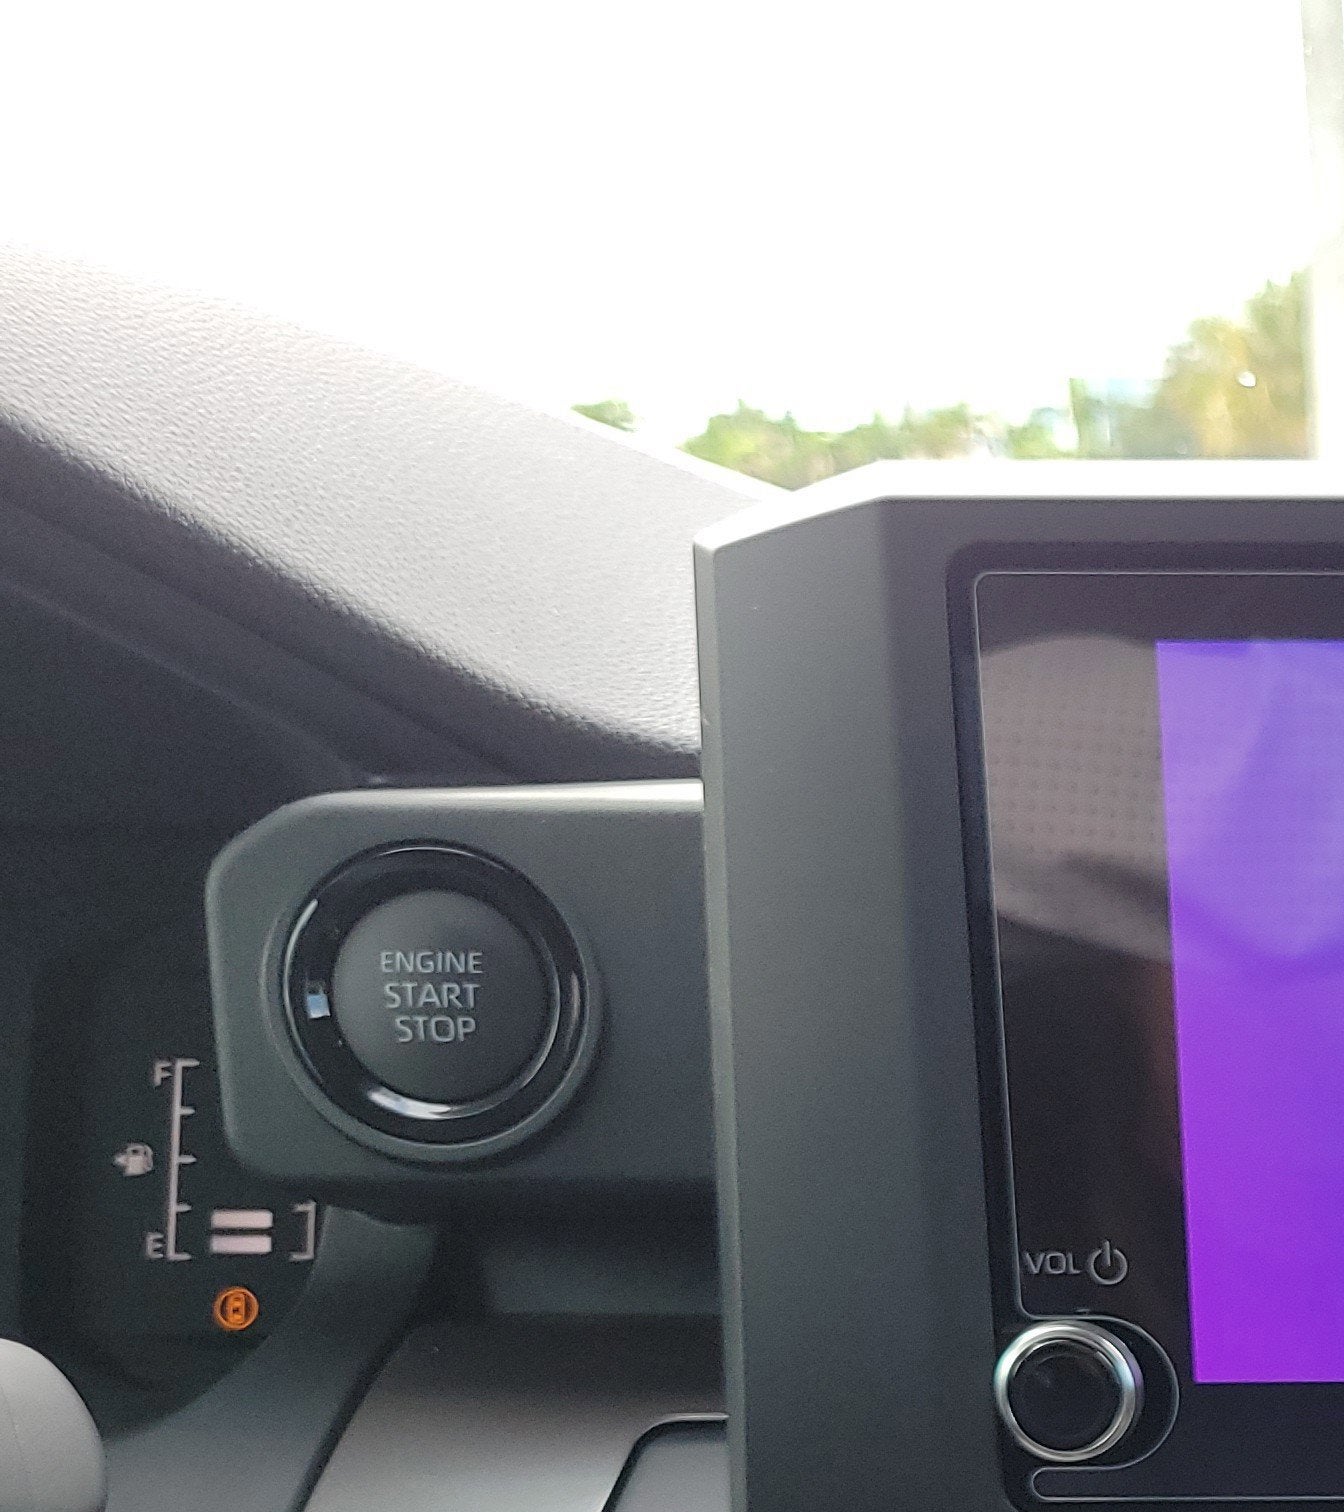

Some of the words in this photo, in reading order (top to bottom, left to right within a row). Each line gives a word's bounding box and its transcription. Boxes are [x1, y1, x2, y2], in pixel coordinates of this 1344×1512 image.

[380, 951, 483, 974] ENGINE
[384, 982, 481, 1009] START
[395, 1015, 477, 1043] STOP
[154, 1060, 172, 1087] F
[145, 1232, 164, 1259] E
[1023, 1251, 1082, 1275] VOL
